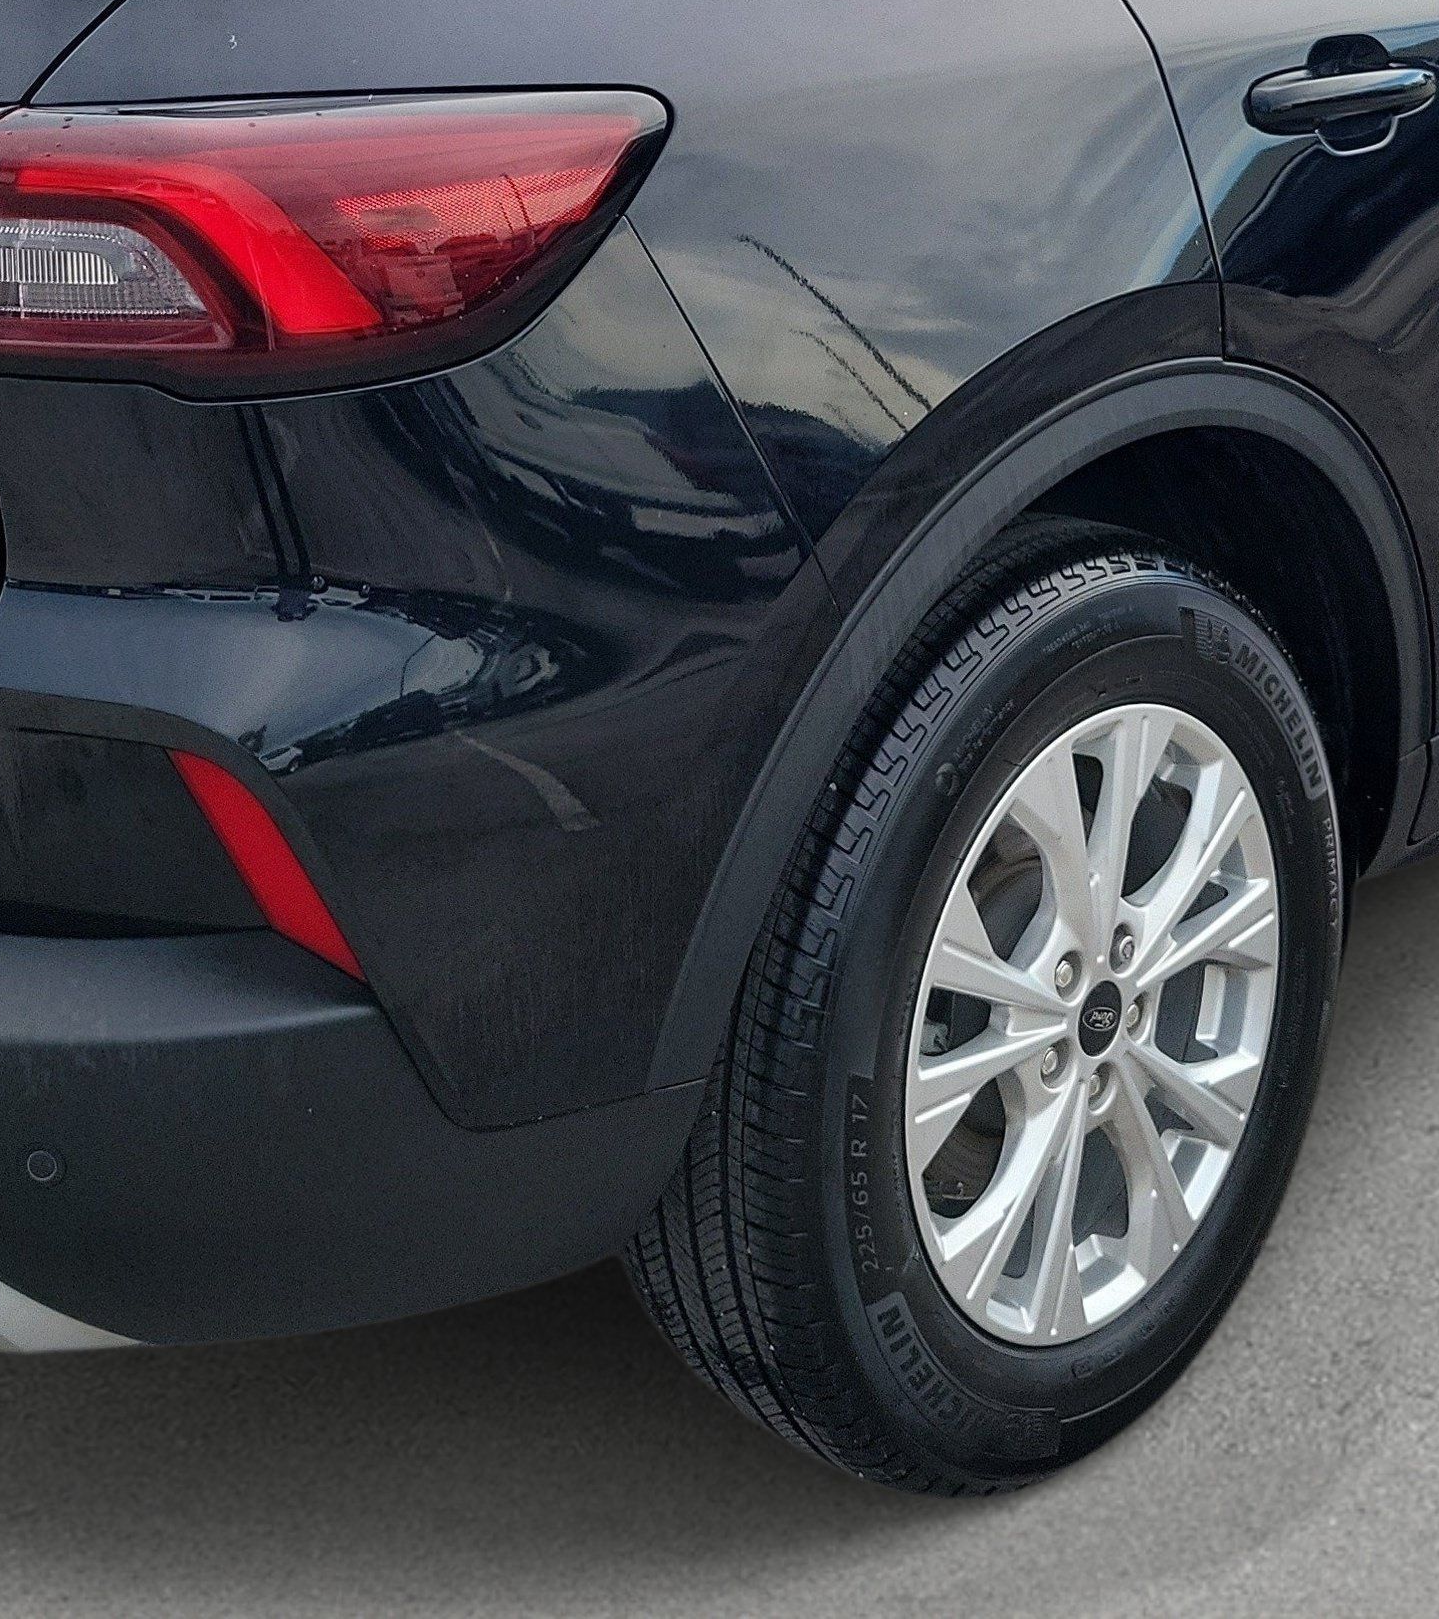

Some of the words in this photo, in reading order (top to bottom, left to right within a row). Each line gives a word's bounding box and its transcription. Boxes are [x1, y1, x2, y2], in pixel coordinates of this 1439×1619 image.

[1233, 642, 1323, 788] MICHELIN
[1321, 816, 1338, 927] PRIMACY
[1088, 1011, 1114, 1028] Ford
[851, 1139, 867, 1158] R
[852, 1093, 868, 1123] 17
[850, 1171, 881, 1273] 225/65
[876, 1304, 963, 1422] CHELIN
